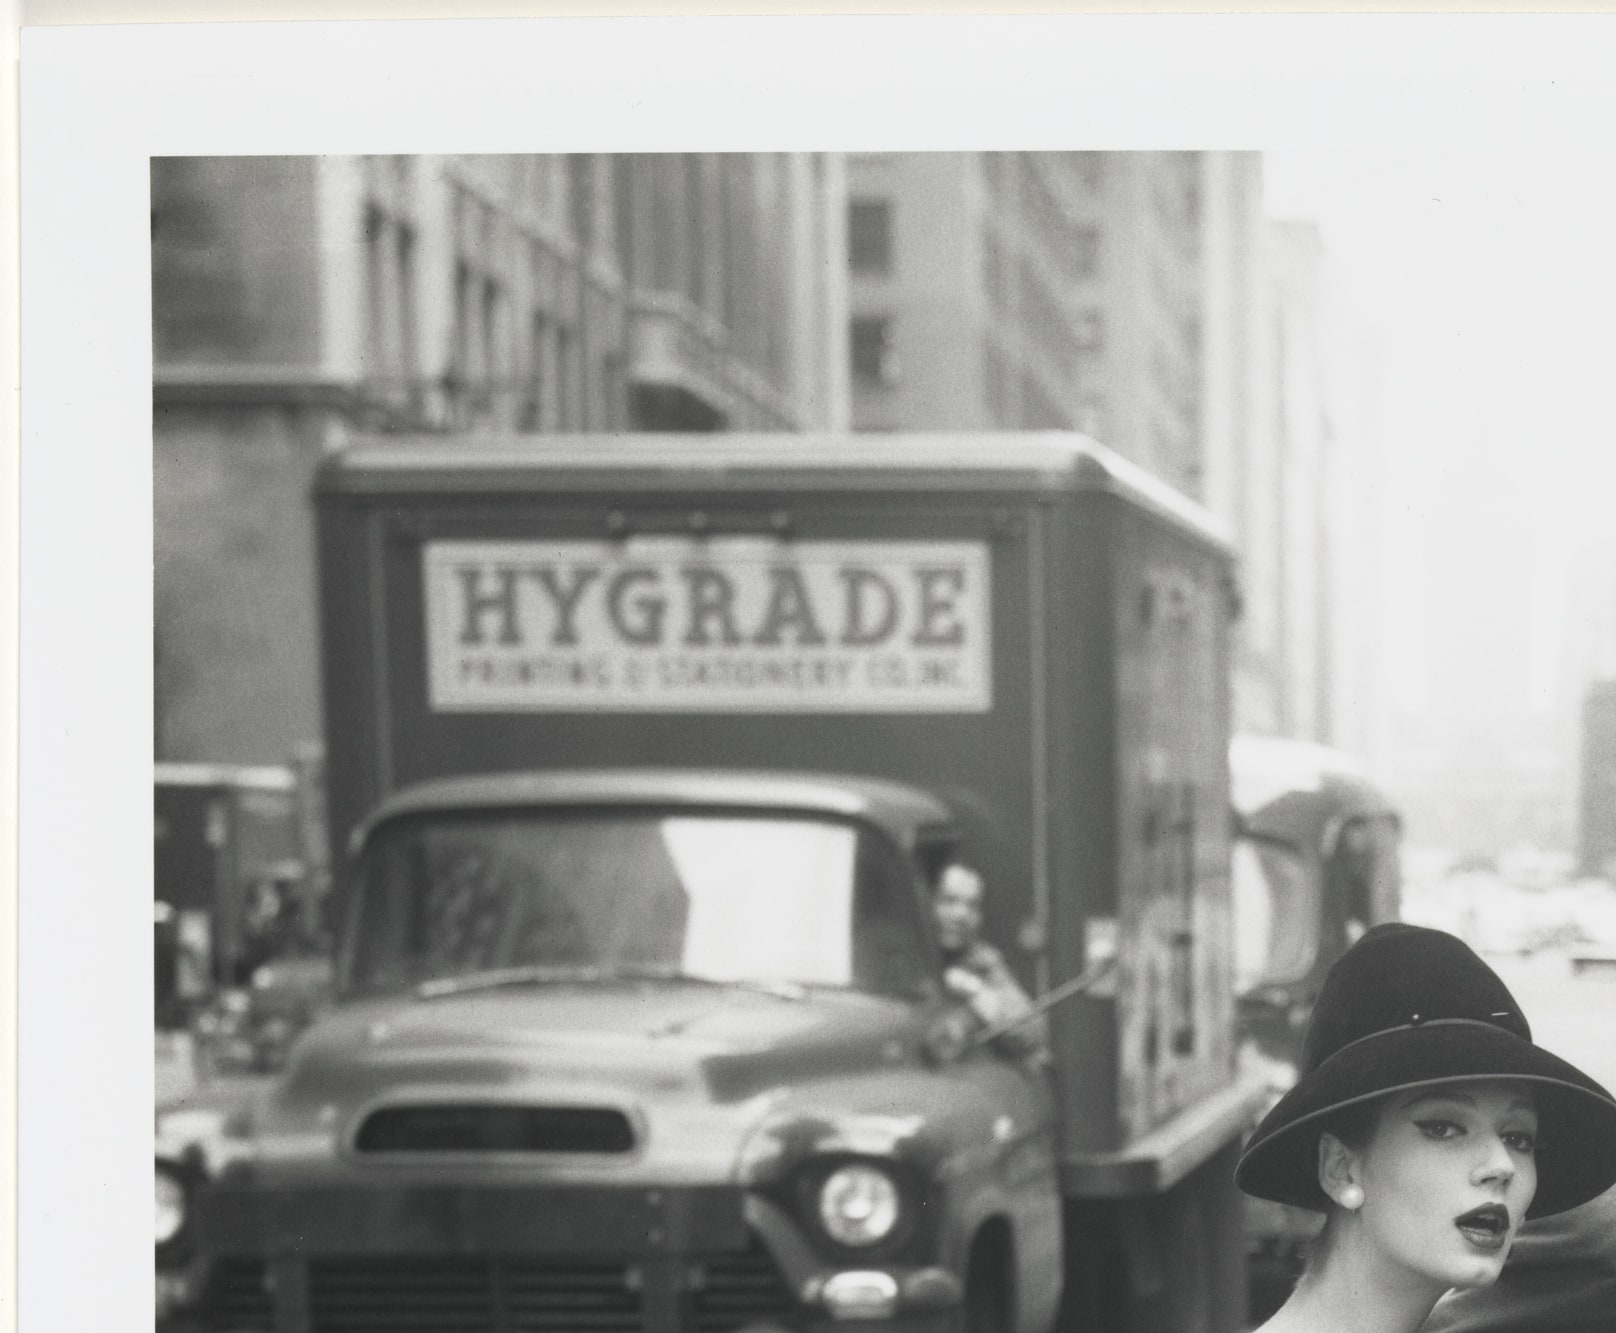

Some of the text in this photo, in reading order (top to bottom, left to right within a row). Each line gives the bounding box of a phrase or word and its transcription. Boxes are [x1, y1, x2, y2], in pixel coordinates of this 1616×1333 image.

[455, 564, 967, 647] HYGRADE
[456, 656, 611, 688] PRINTING
[657, 656, 851, 688] STATIONERY
